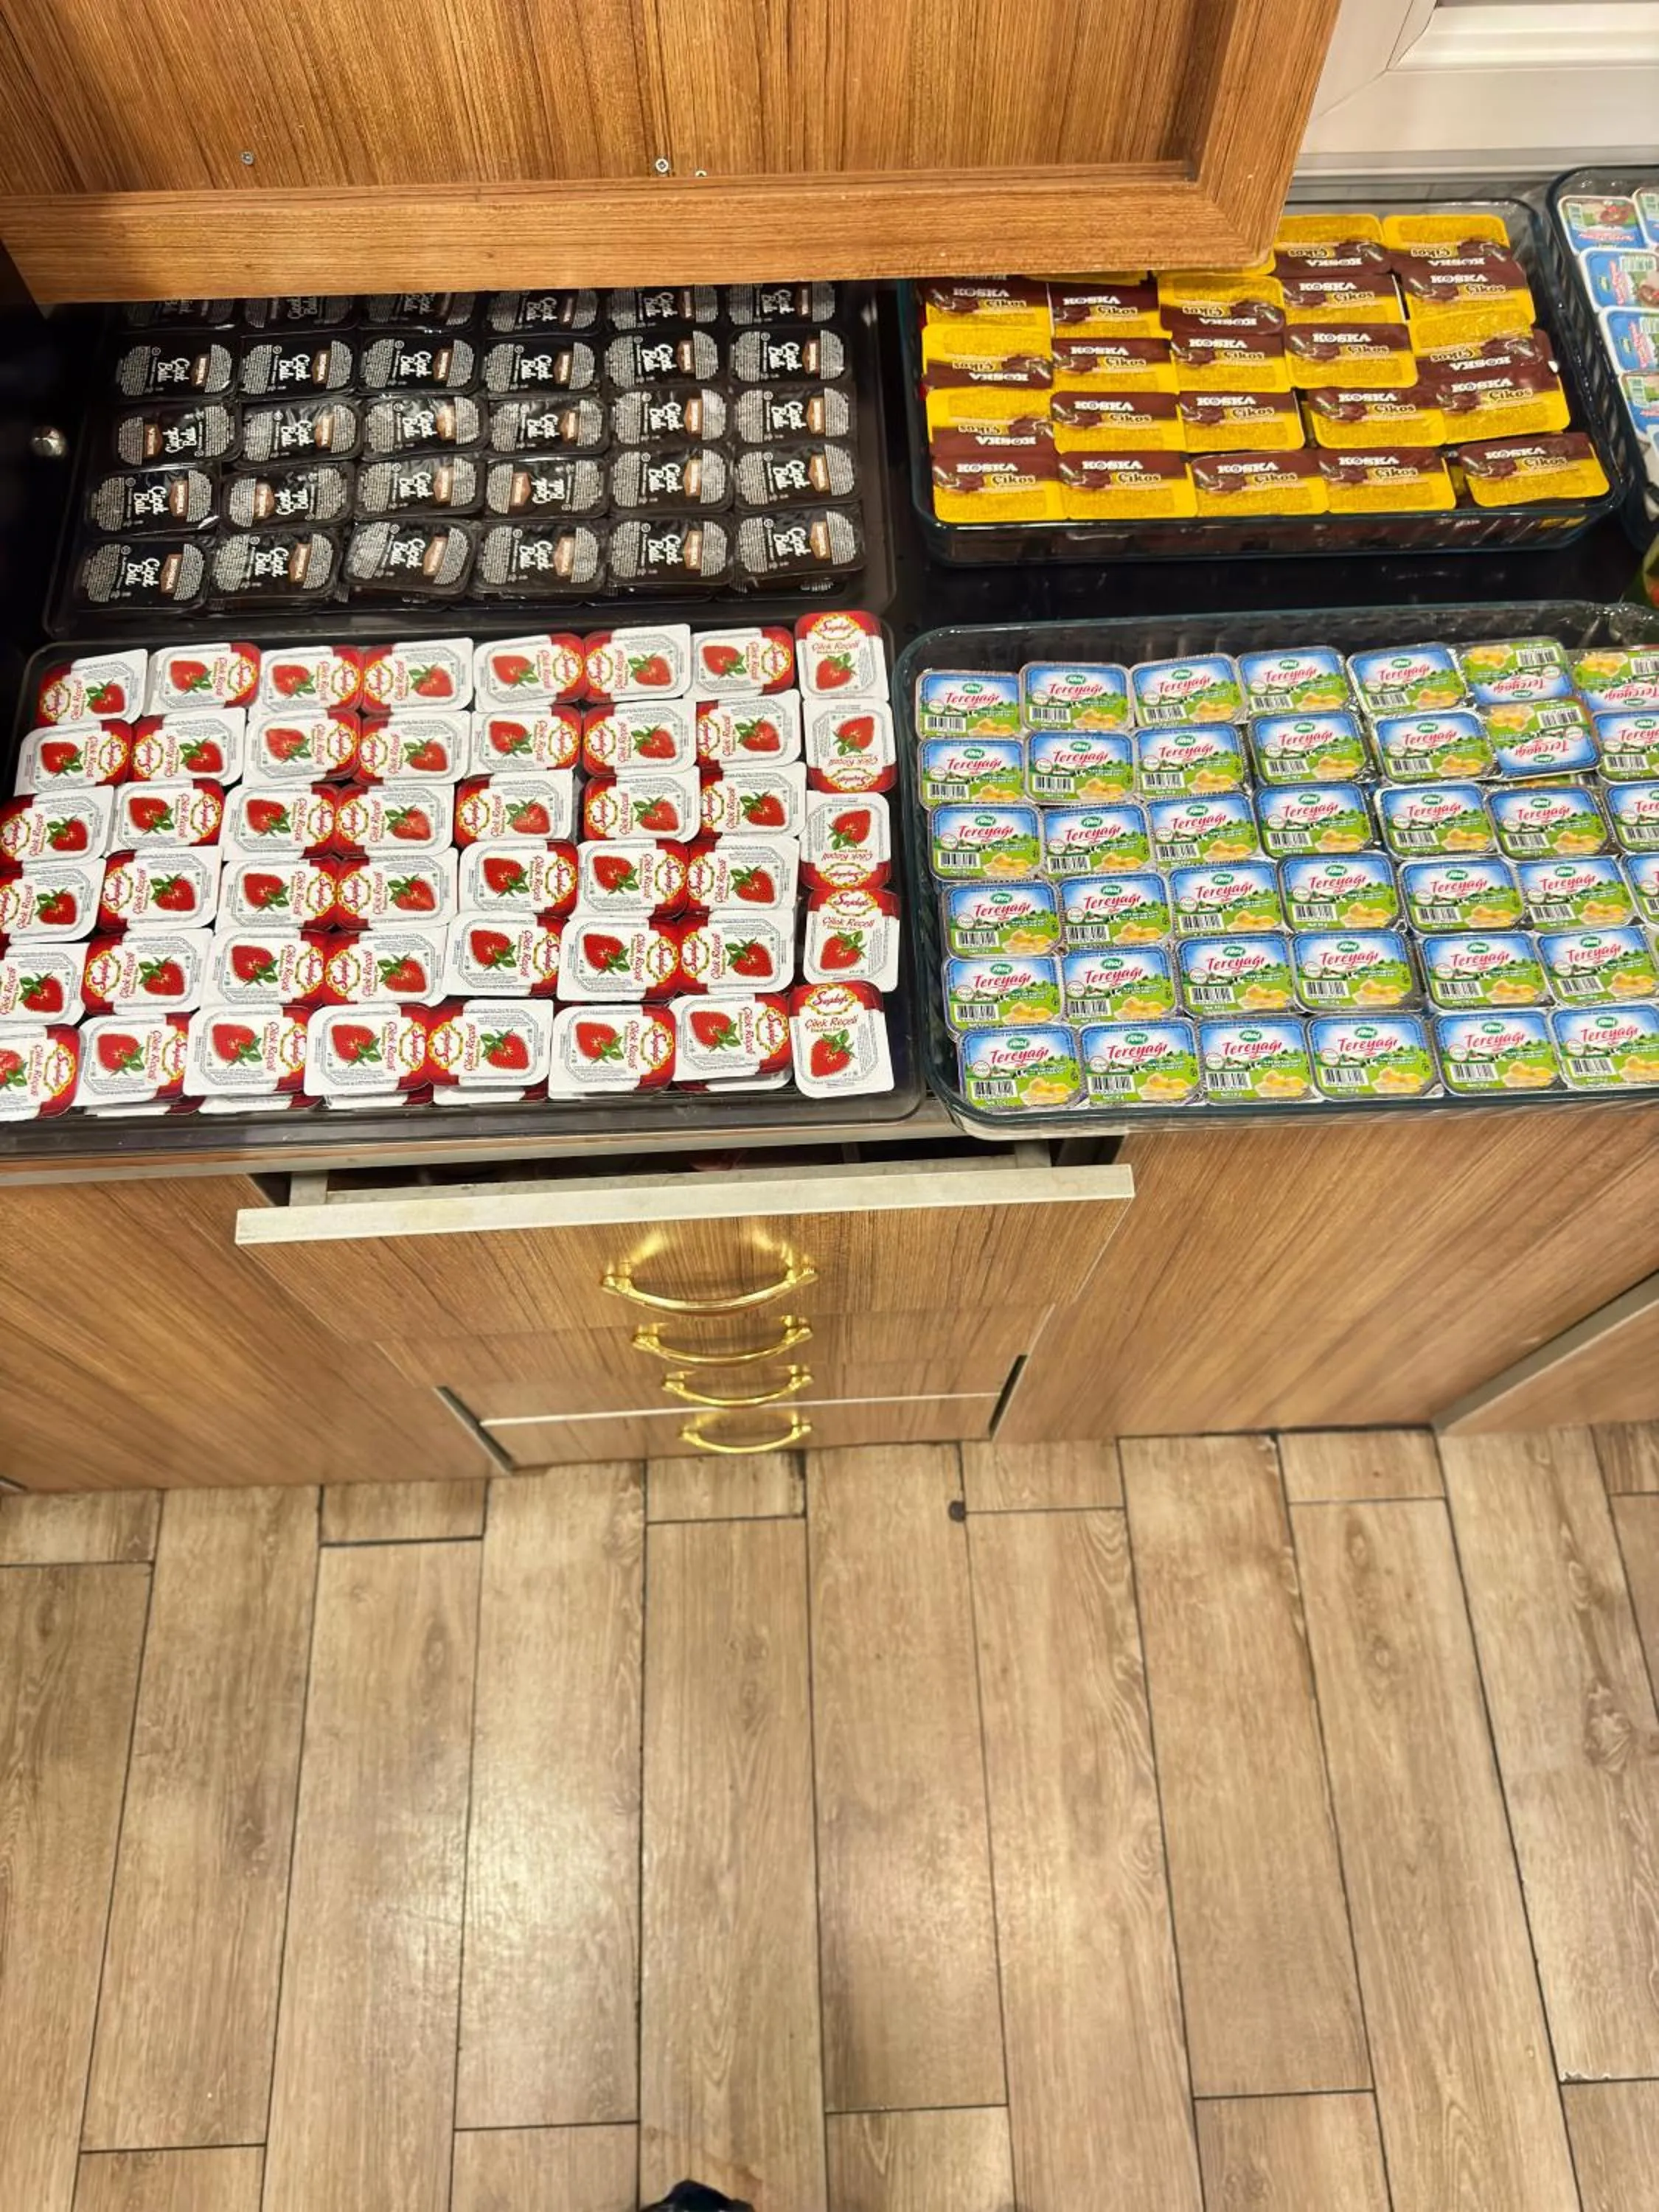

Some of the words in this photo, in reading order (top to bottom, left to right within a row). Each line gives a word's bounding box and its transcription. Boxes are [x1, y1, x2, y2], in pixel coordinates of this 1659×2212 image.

[1306, 257, 1362, 266] KOSKA
[1428, 257, 1485, 266] KOSKA
[1430, 274, 1488, 283] KOSKA
[953, 288, 1009, 296] KOSKA
[1300, 282, 1357, 291] KOSKA
[1465, 284, 1506, 293] Çikos
[1063, 296, 1120, 305] KOSKA
[1334, 292, 1374, 302] Çikos
[986, 299, 1026, 308] Çikos
[1097, 307, 1137, 316] Çikos
[1199, 318, 1256, 326] KOSKA
[1189, 339, 1248, 348] KOSKA
[1312, 333, 1371, 342] KOSKA
[1071, 347, 1128, 355] KOSKA
[1348, 344, 1388, 355] Çikos
[1105, 357, 1146, 367] Çikos
[1224, 351, 1265, 361] Çikos
[1450, 357, 1511, 371] KOSKA
[969, 372, 1029, 382] KOSKA
[1452, 378, 1513, 392] KOSKA
[1338, 392, 1397, 401] KOSKA
[1488, 389, 1532, 400] Çikos
[1074, 401, 1134, 411] KOSKA
[1197, 397, 1256, 406] KOSKA
[1232, 407, 1274, 418] Çikos
[1374, 403, 1415, 413] Çikos
[1109, 413, 1152, 423] Çikos
[975, 436, 1036, 445] KOSKA
[1485, 447, 1545, 459] KOSKA
[1082, 461, 1144, 470] KOSKA
[1338, 456, 1398, 465] KOSKA
[1524, 456, 1566, 467] Çikos
[956, 463, 1018, 473] KOSKA
[1217, 462, 1279, 473] KOSKA
[1374, 467, 1417, 477] Çikos
[992, 474, 1035, 485] Çikos
[1118, 473, 1161, 483] Çikos
[1254, 473, 1297, 483] Çikos
[1265, 667, 1315, 681] Tereyağı
[1378, 665, 1430, 682] Tereyağı
[1048, 684, 1103, 697] Tereyağı
[1159, 677, 1211, 692] Tereyağı
[945, 692, 1001, 706] Tereyağı
[1279, 731, 1334, 745] Tereyağı
[1402, 731, 1458, 745] Tereyağı
[1158, 743, 1214, 757] Tereyağı
[1054, 751, 1108, 764] Tereyağı
[947, 758, 1004, 771] Tereyağı
[1282, 802, 1338, 818] Tereyağı
[1407, 803, 1461, 817] Tereyağı
[1517, 807, 1572, 820] Tereyağı
[1172, 814, 1228, 829] Tereyağı
[959, 825, 1015, 838] Tereyağı
[1065, 825, 1121, 841] Tereyağı
[1309, 875, 1366, 891] Tereyağı
[1431, 880, 1487, 894] Tereyağı
[1539, 875, 1596, 891] Tereyağı
[1194, 883, 1253, 900] Tereyağı
[1084, 894, 1141, 911] Tereyağı
[975, 905, 1032, 919] Tereyağı
[1566, 944, 1622, 960] Tereyağı
[1208, 956, 1265, 972] Tereyağı
[1320, 951, 1380, 966] Tereyağı
[1452, 952, 1511, 967] Tereyağı
[1085, 968, 1142, 984] Tereyağı
[975, 975, 1032, 990] Tereyağı
[1582, 1025, 1639, 1041] Tereyağı
[1338, 1038, 1398, 1053] Tereyağı
[1464, 1032, 1524, 1049] Tereyağı
[1108, 1043, 1166, 1059] Tereyağı
[1224, 1041, 1283, 1057] Tereyağı
[991, 1048, 1049, 1065] Tereyağı
